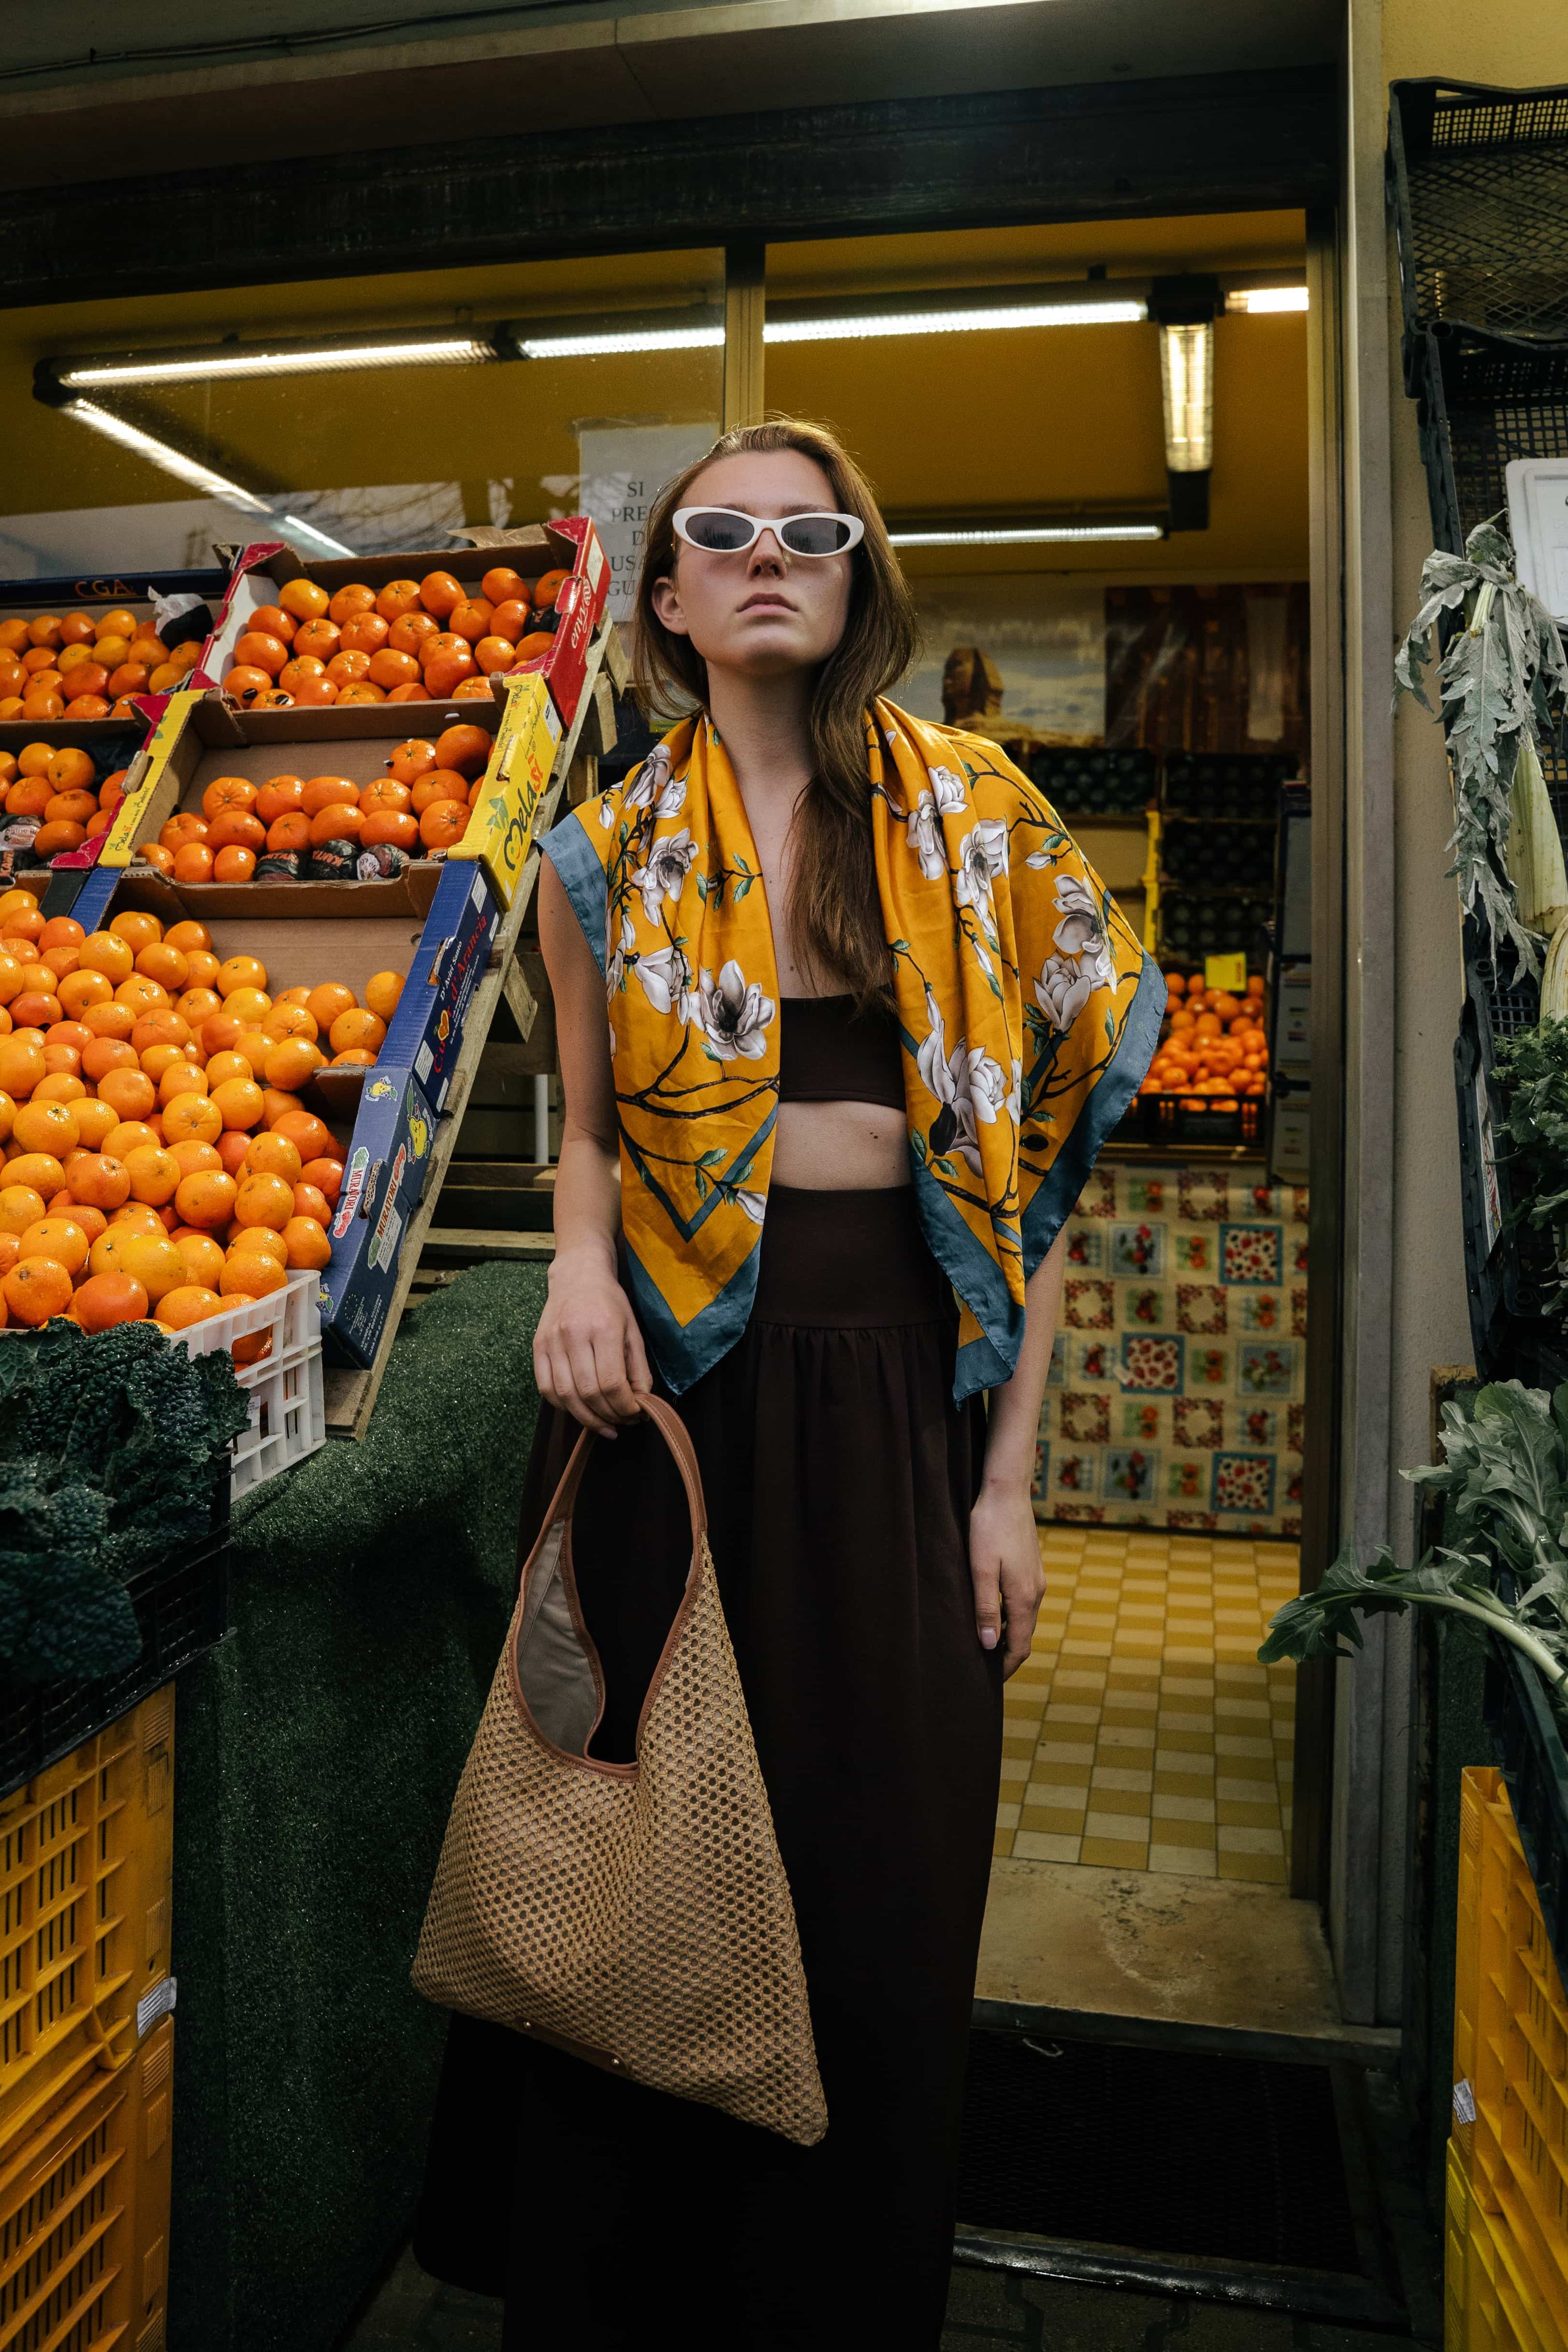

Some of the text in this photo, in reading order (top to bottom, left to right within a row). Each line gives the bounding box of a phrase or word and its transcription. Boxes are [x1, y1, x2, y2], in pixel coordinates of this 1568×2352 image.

[627, 481, 644, 498] SI
[74, 579, 136, 598] CGA
[452, 941, 462, 965] Santo
[377, 1180, 397, 1239] MURATORI
